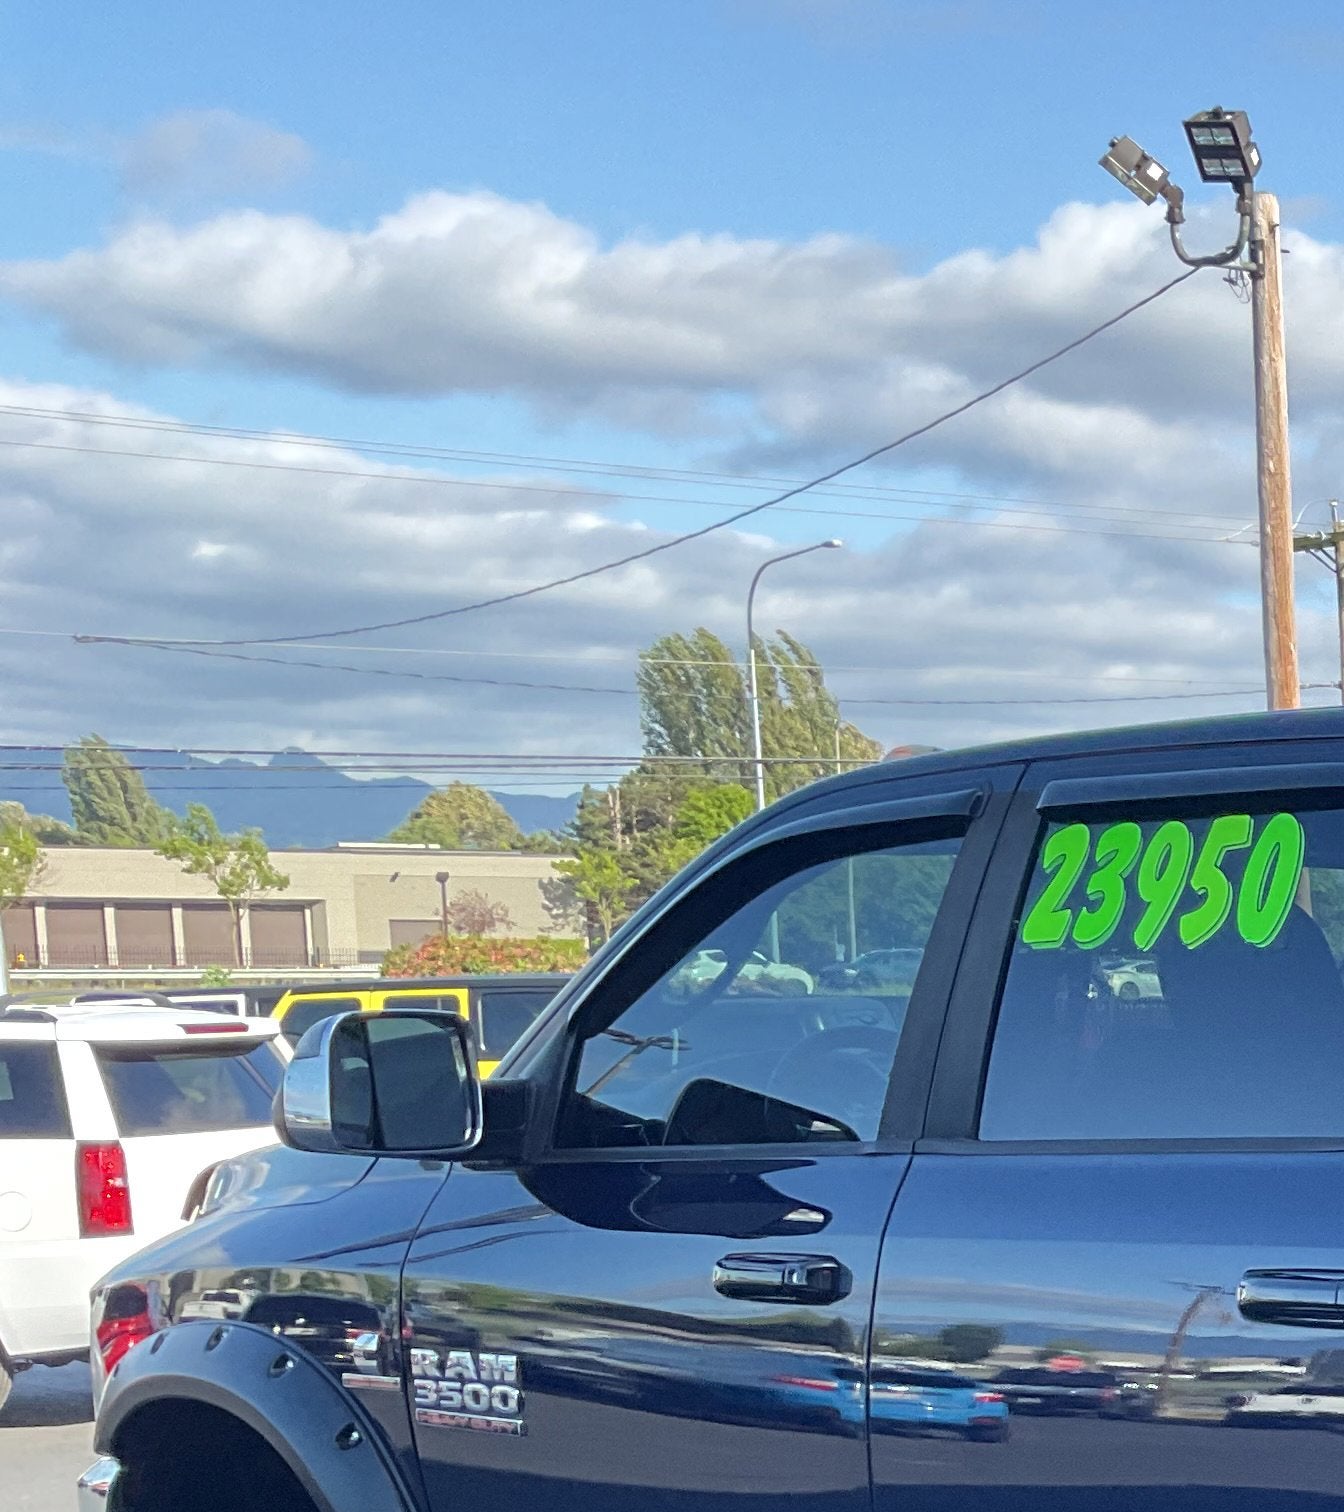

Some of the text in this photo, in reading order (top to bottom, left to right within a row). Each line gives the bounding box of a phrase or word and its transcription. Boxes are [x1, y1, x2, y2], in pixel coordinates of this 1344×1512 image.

[1022, 811, 1306, 952] 23950
[411, 1348, 518, 1382] RAM
[414, 1379, 521, 1415] 3500
